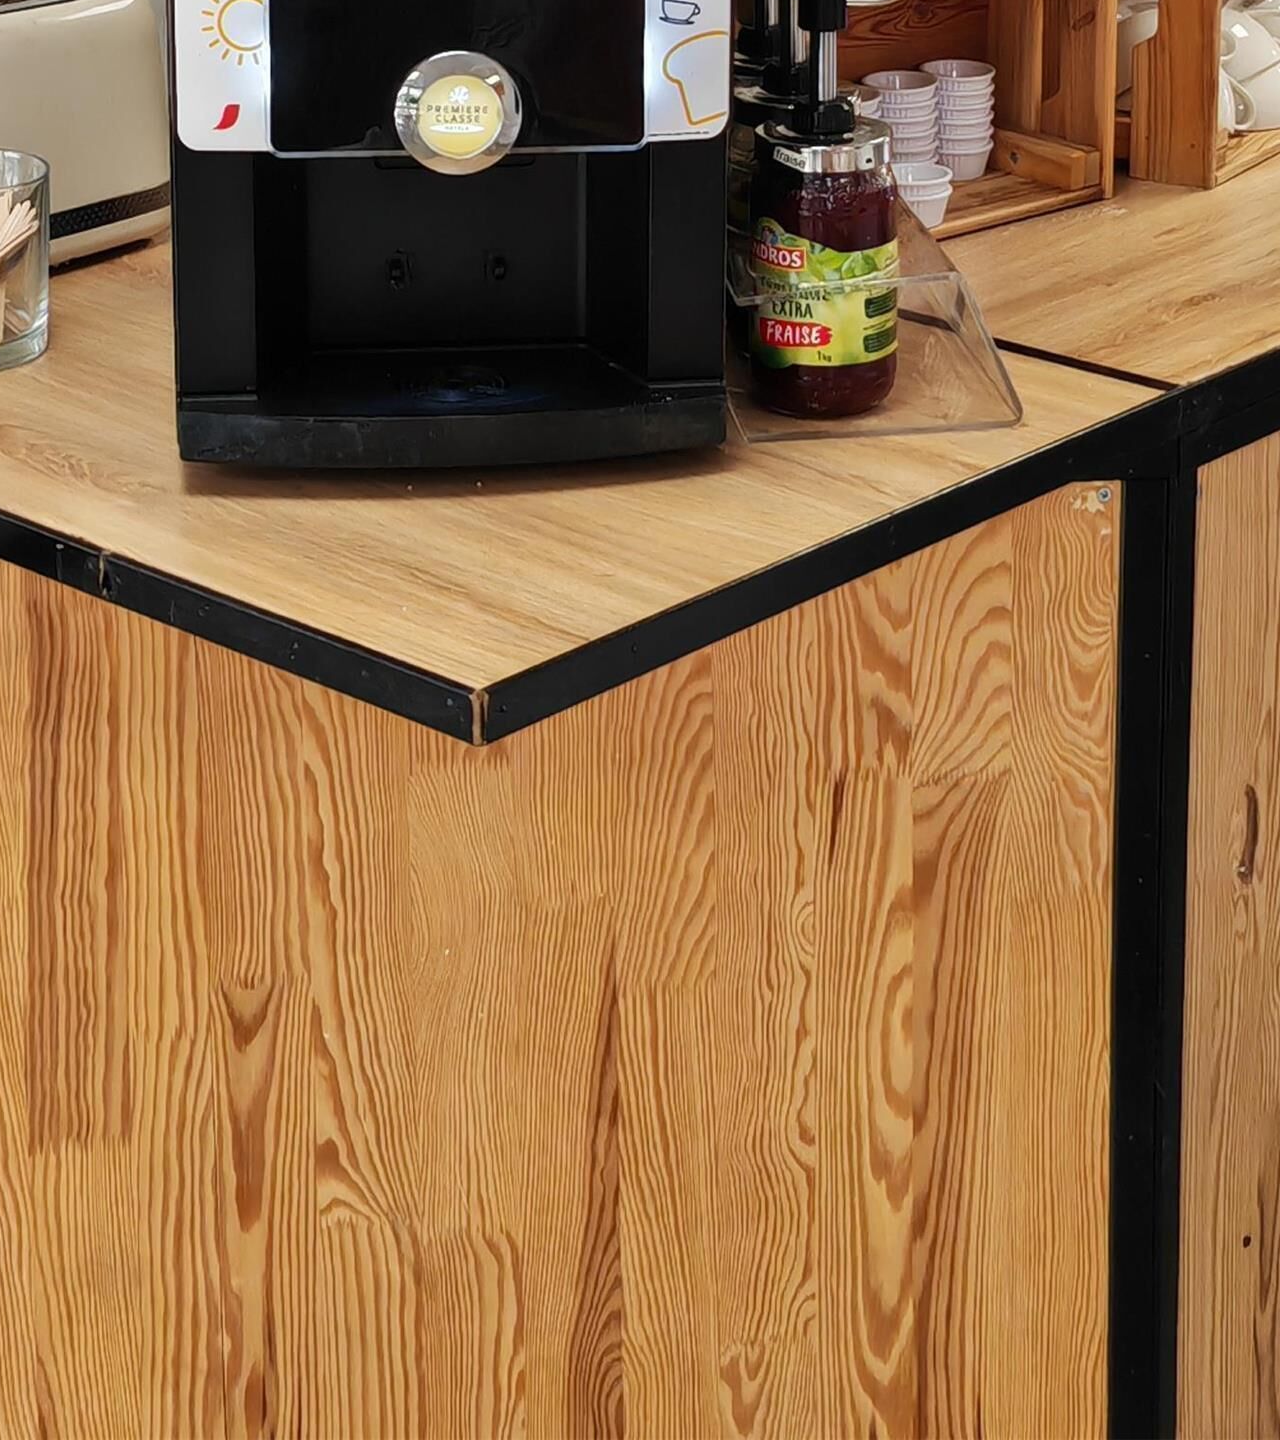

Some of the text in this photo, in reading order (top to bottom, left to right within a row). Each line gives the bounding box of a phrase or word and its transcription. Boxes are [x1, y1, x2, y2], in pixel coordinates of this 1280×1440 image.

[435, 114, 481, 124] CLASSE
[776, 147, 806, 169] fraise
[772, 299, 813, 319] EXTRA
[766, 320, 822, 345] FRAISE
